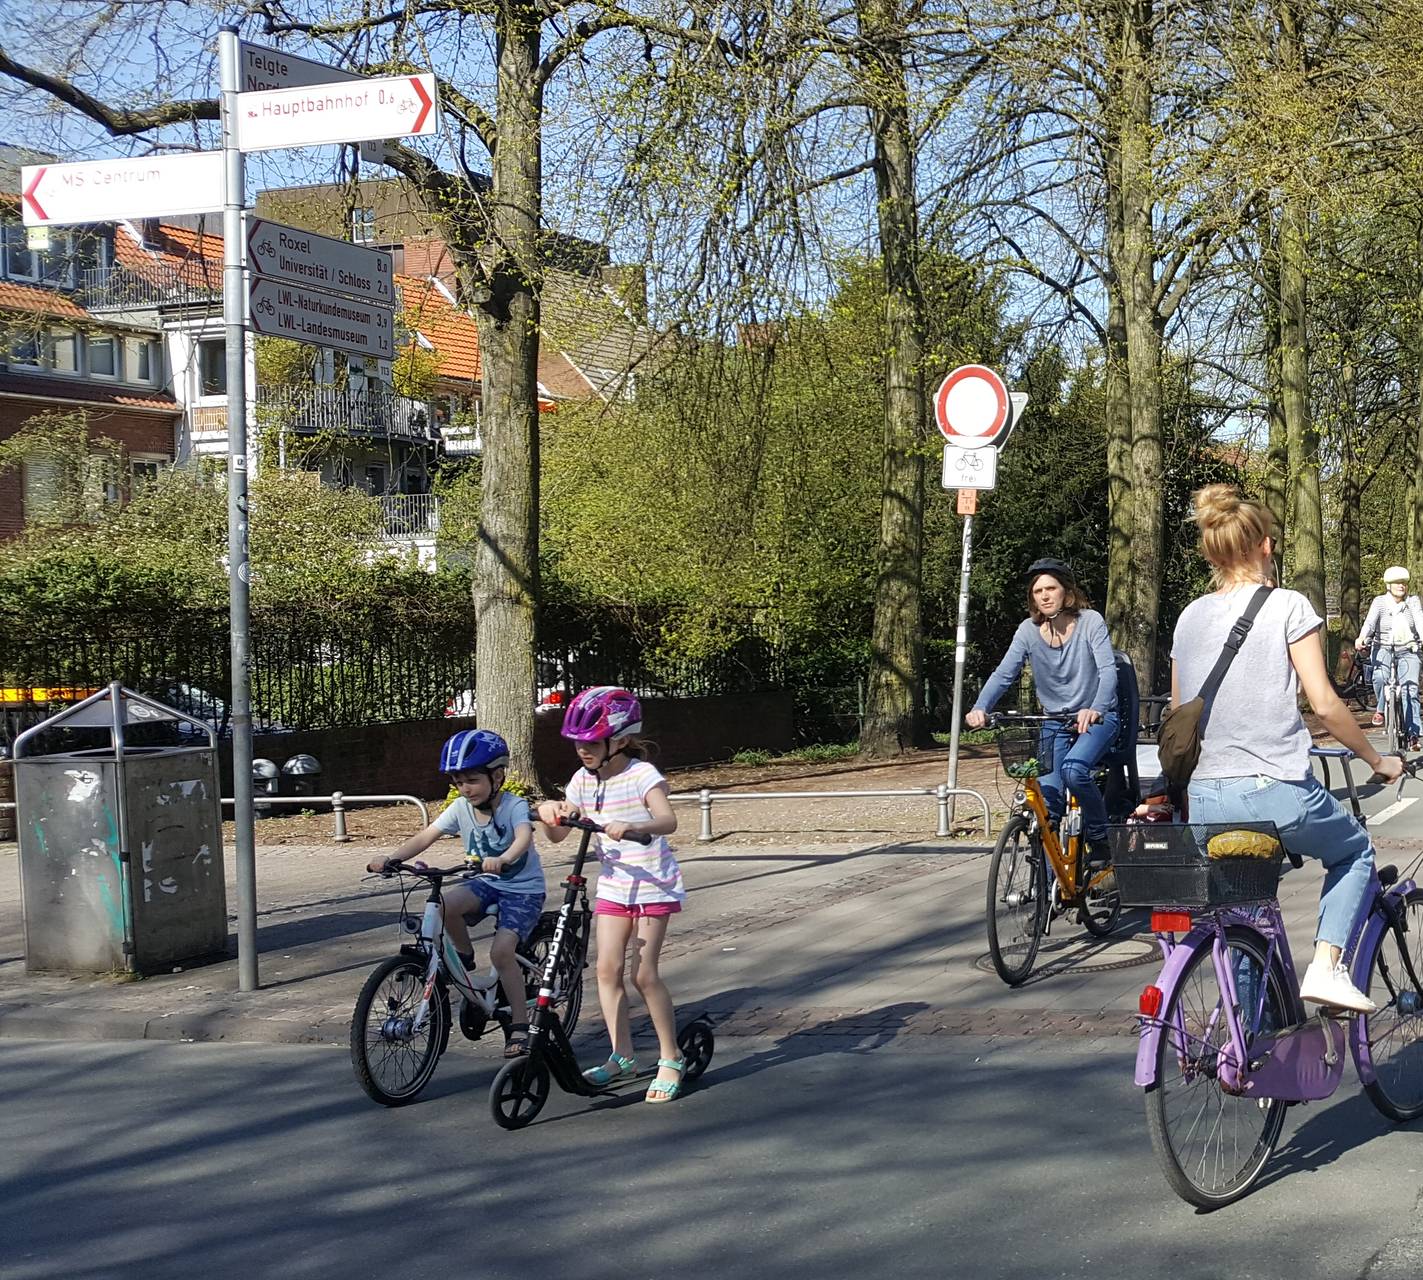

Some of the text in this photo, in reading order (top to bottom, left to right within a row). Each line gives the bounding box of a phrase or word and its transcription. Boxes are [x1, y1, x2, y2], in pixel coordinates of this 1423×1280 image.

[247, 51, 288, 76] Telgte
[262, 93, 369, 118] Hauptbahnhof
[61, 168, 161, 187] MS Centrum
[279, 232, 312, 254] Roxel
[279, 255, 329, 281] Universität
[338, 269, 371, 291] Schloss
[277, 289, 371, 325] LWL-Naturkundemuseum
[278, 312, 368, 345] LWL-Landesmuseum
[543, 903, 570, 981] HUDORA
